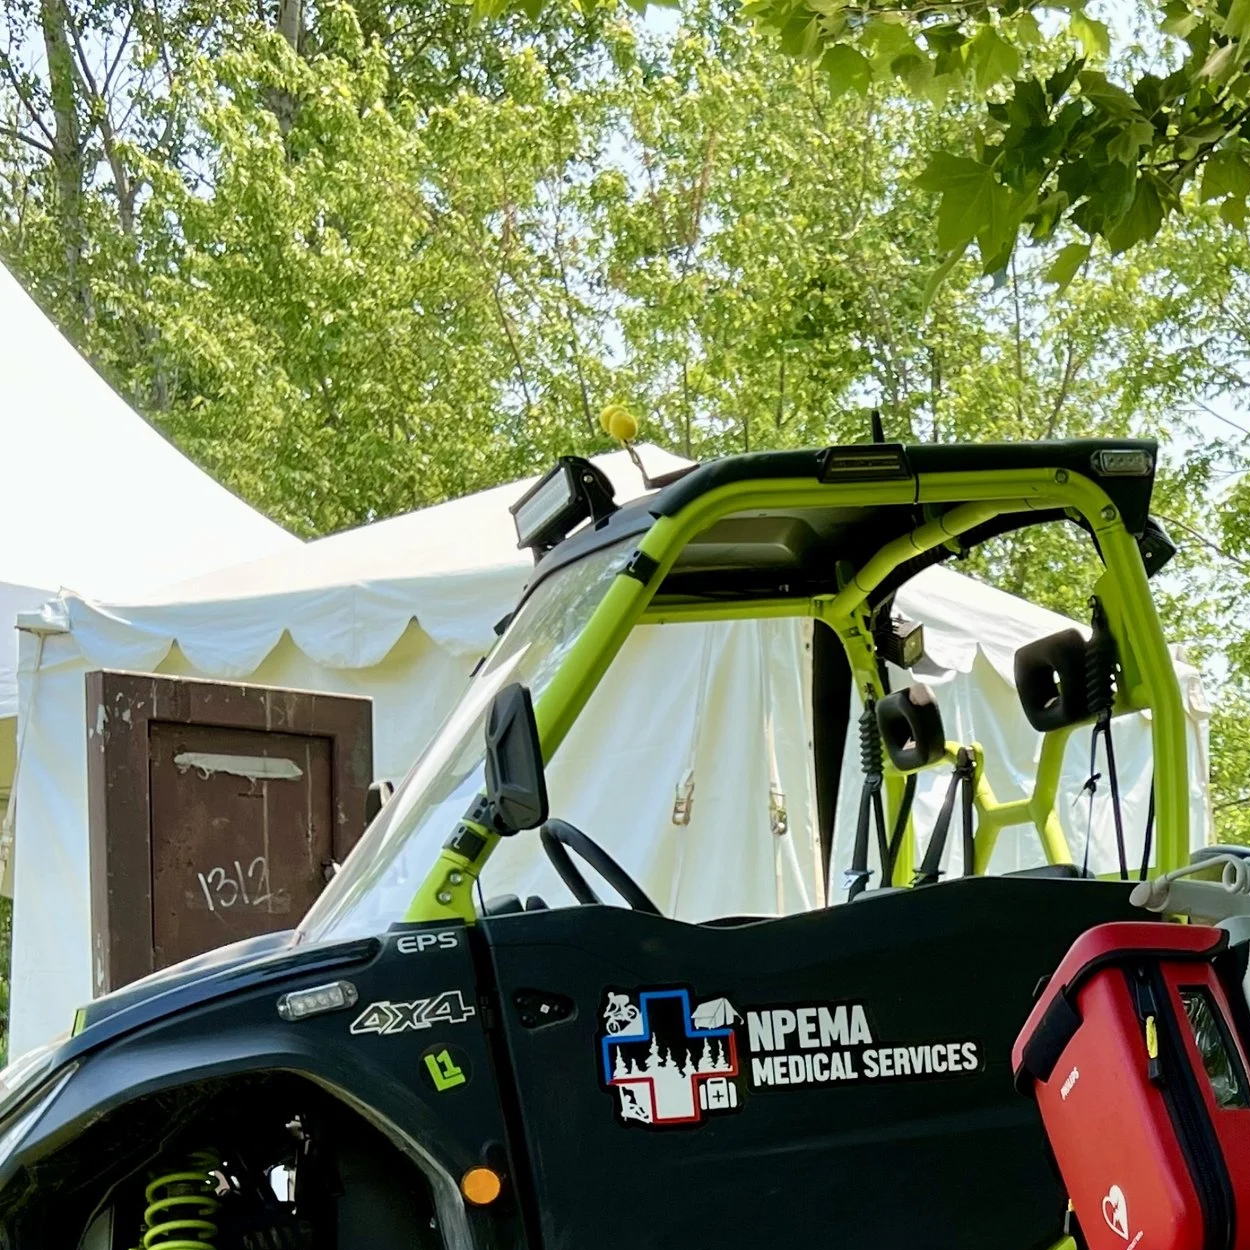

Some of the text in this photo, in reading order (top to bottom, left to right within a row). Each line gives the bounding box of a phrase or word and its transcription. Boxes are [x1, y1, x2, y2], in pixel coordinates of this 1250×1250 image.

[198, 856, 276, 911] 1312
[397, 932, 458, 953] EPS
[747, 1005, 873, 1052] NPEMA
[753, 1042, 978, 1087] MEDICAL SERVICES
